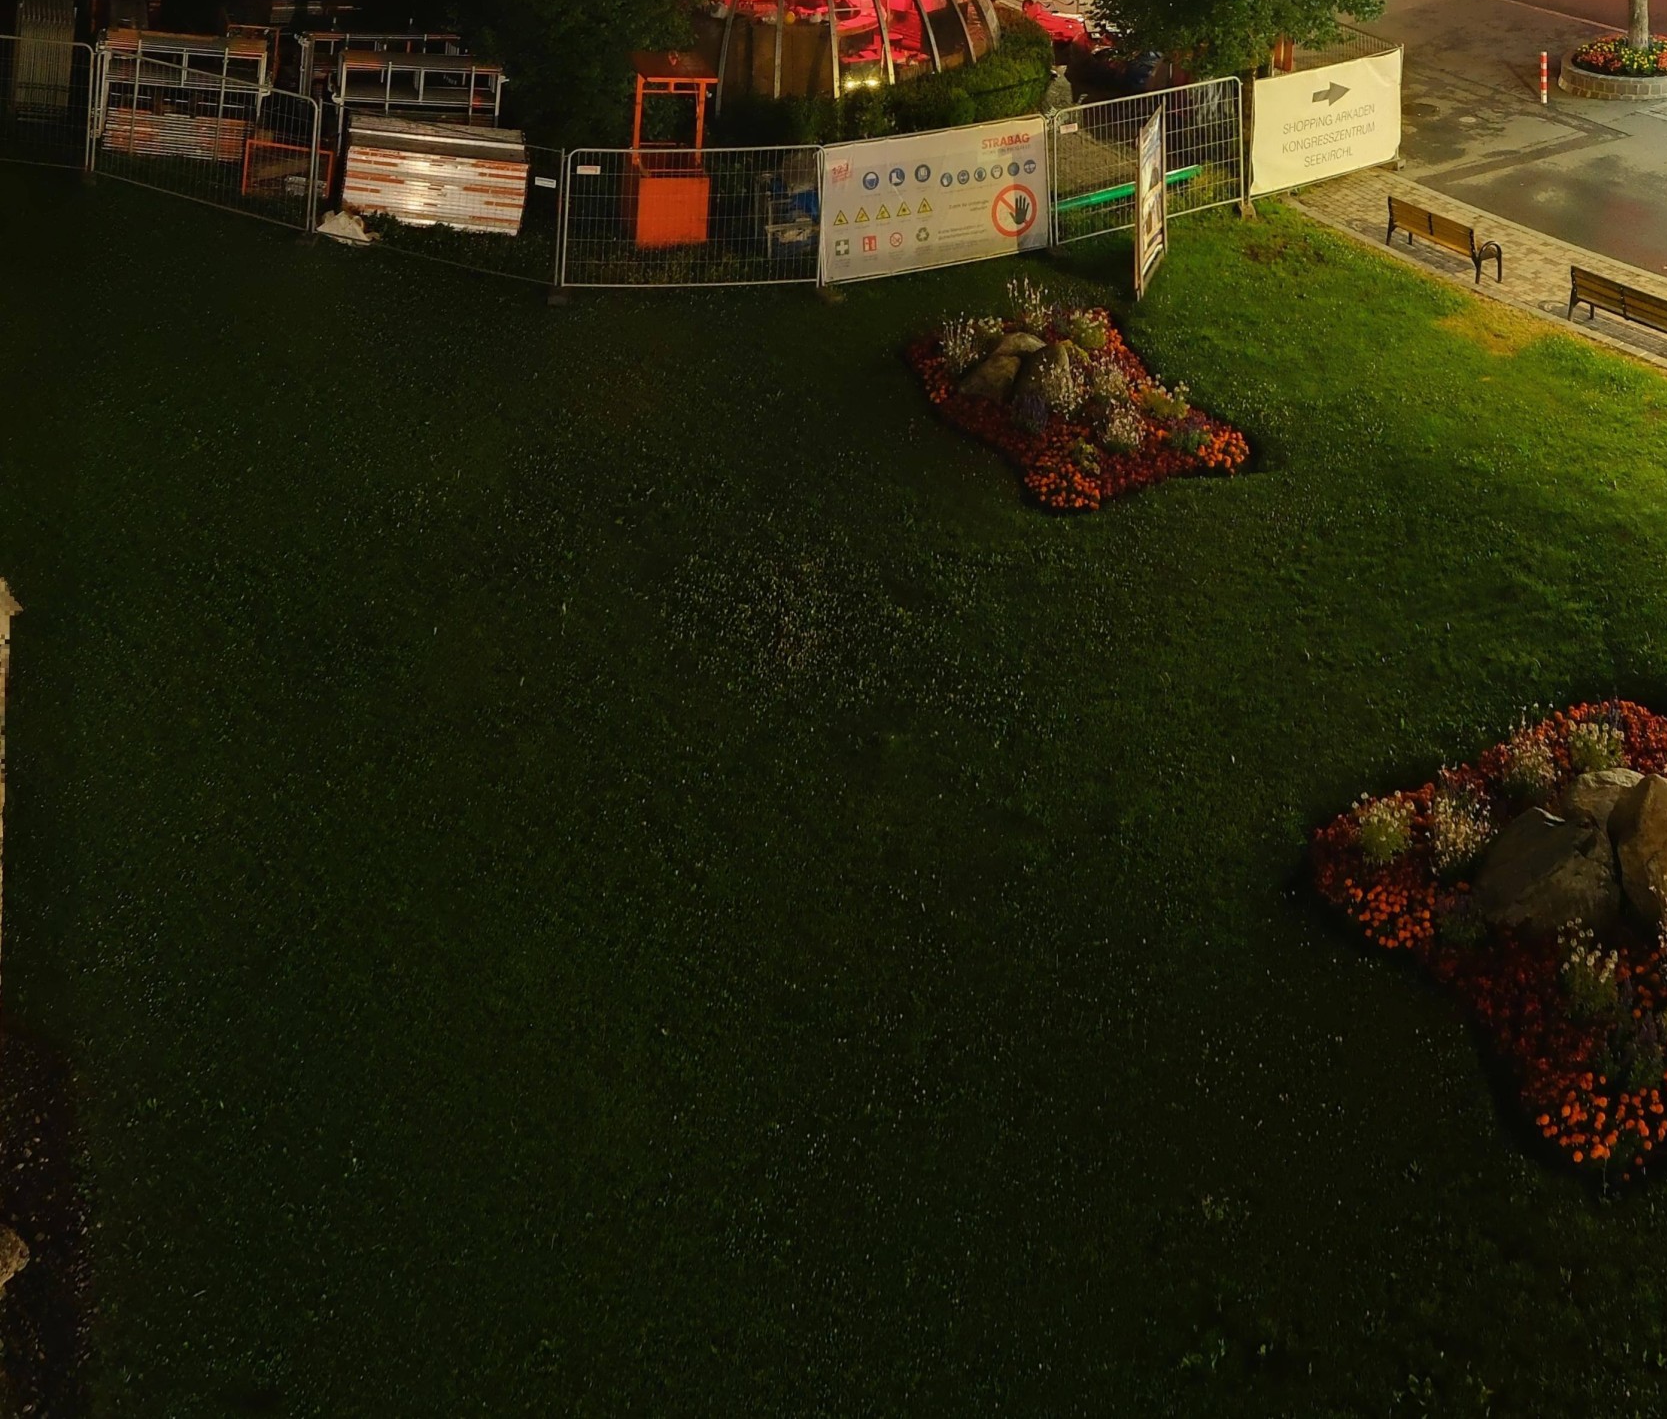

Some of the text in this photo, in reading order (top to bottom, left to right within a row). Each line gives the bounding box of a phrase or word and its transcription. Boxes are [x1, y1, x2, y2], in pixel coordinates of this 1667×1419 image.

[1282, 103, 1375, 135] SHOPPING ARKADEN
[981, 133, 1031, 150] STRABAG
[1282, 121, 1376, 154] KONGRESSZENTRUM
[1303, 146, 1354, 168] SEEKIRCHL
